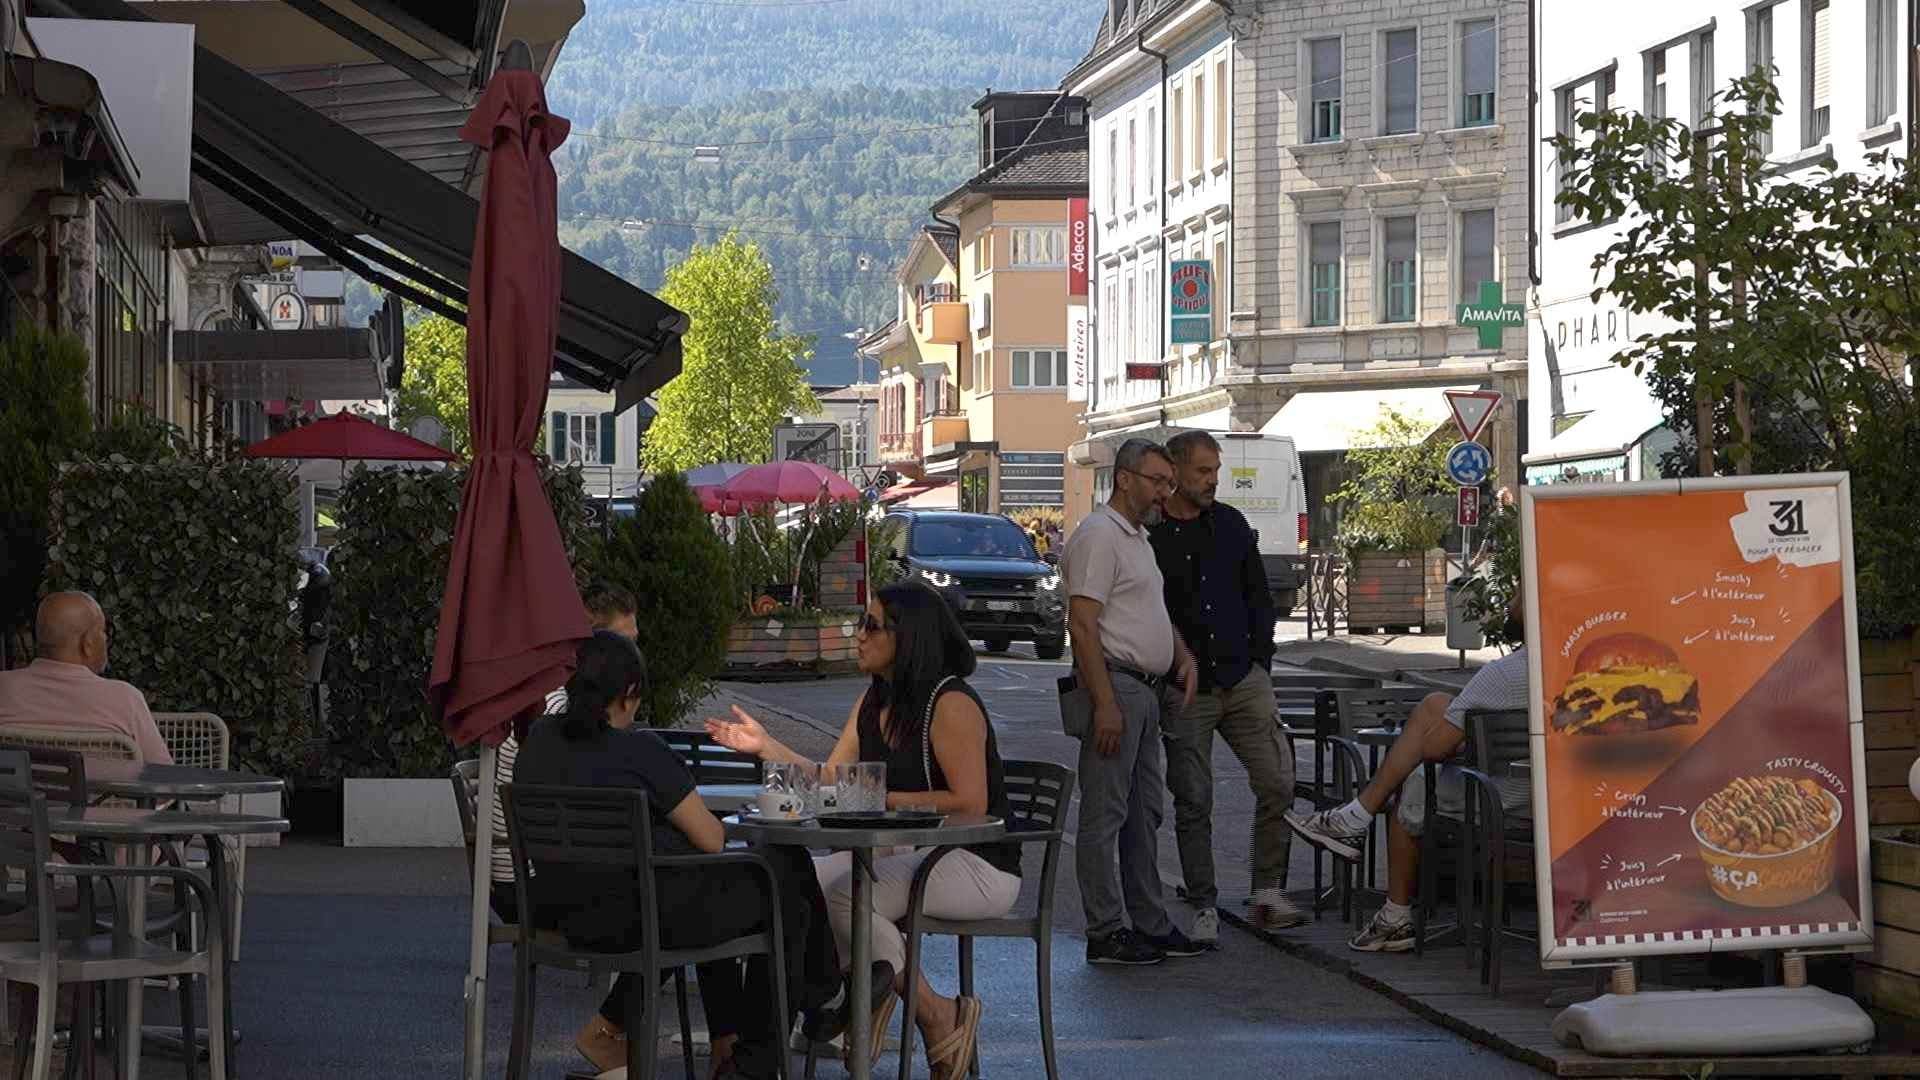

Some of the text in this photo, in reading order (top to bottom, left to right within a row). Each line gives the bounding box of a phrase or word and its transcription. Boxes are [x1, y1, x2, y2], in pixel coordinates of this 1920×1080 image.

[1072, 220, 1085, 272] Adecco
[279, 273, 296, 282] Bar
[1461, 306, 1522, 323] AMAVITA
[1768, 500, 1808, 537] 31
[1560, 611, 1627, 657] SMASH BURGER
[1766, 757, 1847, 793] TASTY CROUSTY
